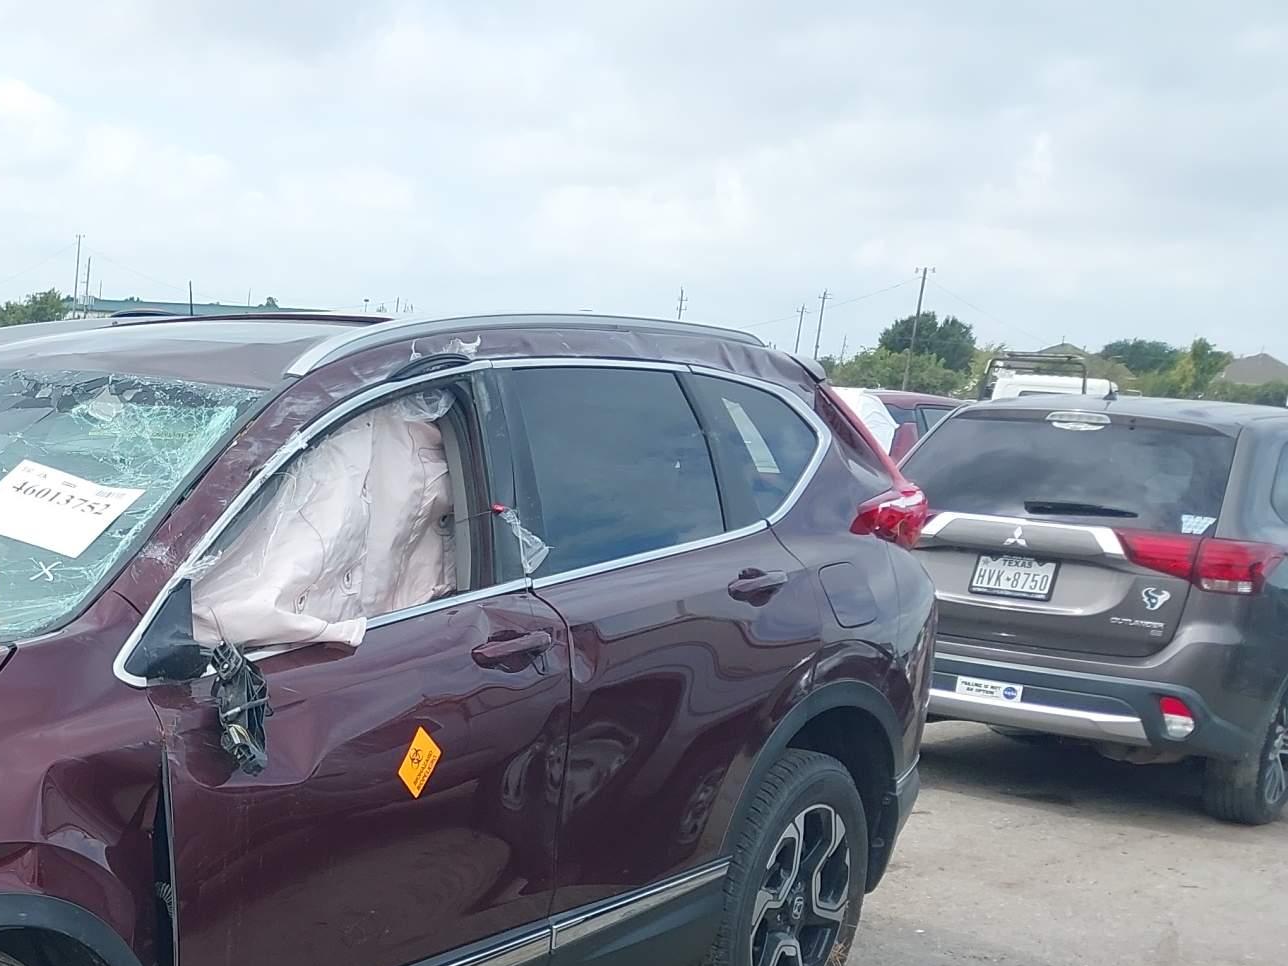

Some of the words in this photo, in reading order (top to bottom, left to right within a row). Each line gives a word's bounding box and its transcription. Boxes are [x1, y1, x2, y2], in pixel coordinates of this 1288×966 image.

[12, 481, 111, 515] 46013752
[1002, 559, 1033, 569] TEXAS
[975, 567, 1005, 587] HVK
[1010, 571, 1049, 591] 8750
